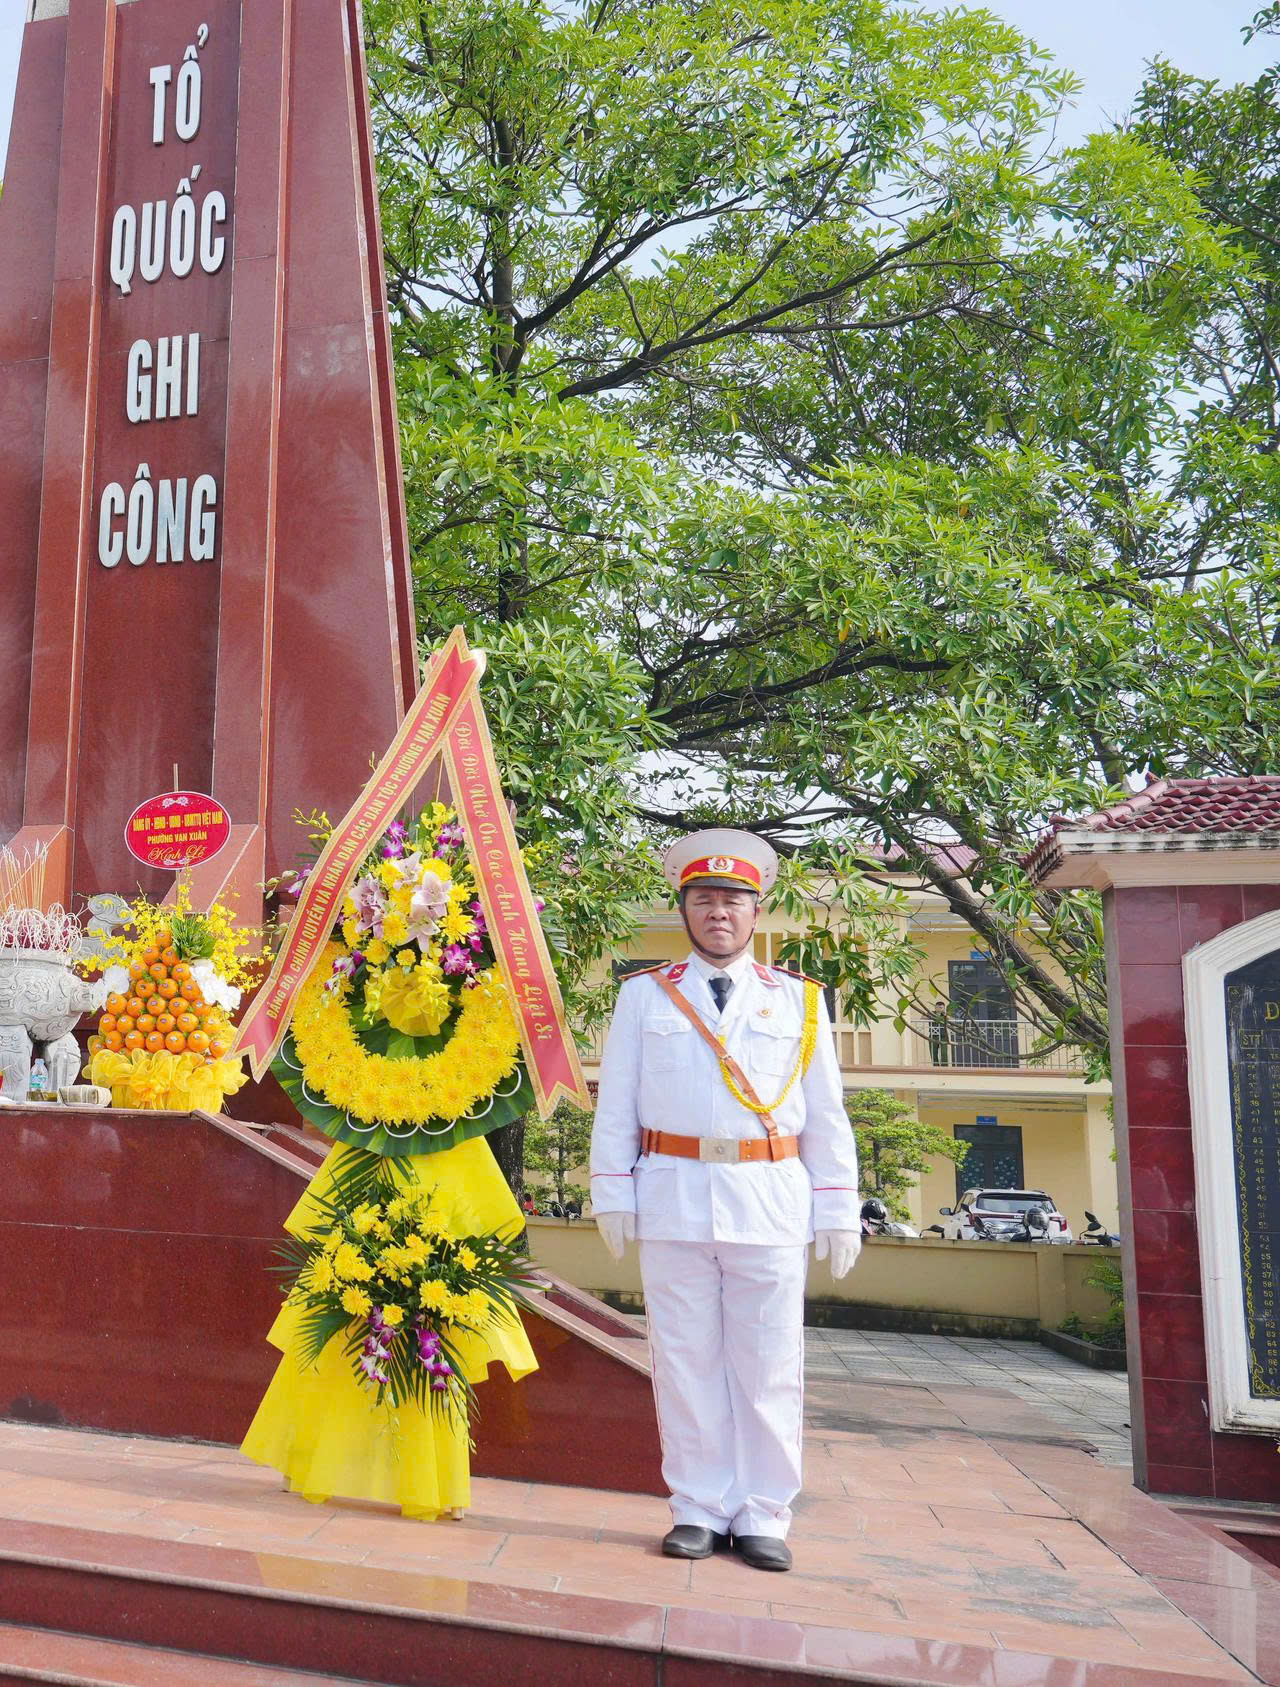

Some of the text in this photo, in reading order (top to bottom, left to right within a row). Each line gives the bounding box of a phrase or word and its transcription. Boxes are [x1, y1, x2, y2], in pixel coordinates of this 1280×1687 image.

[149, 22, 210, 145] TỔ
[109, 164, 227, 297] QUỐC
[125, 332, 201, 427] GHI
[97, 462, 217, 569] CÔNG
[425, 693, 451, 727] XUÂN
[416, 720, 438, 748] VẠN
[392, 743, 423, 782] PHƯỜNG
[376, 777, 399, 804] TỘC
[364, 798, 386, 822] DÂN
[147, 832, 174, 845] PHƯỜNG
[189, 830, 208, 841] XUÂN
[350, 817, 372, 841] CÁC
[339, 838, 359, 861] DÂN
[322, 862, 347, 891] NHÂN
[319, 885, 333, 909] VÀ
[495, 883, 520, 922] Anh
[302, 905, 322, 939] QUYỀN
[290, 941, 312, 972] CHÍNH
[507, 926, 531, 980] Hùng
[266, 997, 287, 1020] ĐẢNG
[522, 983, 548, 1019] Liệt
